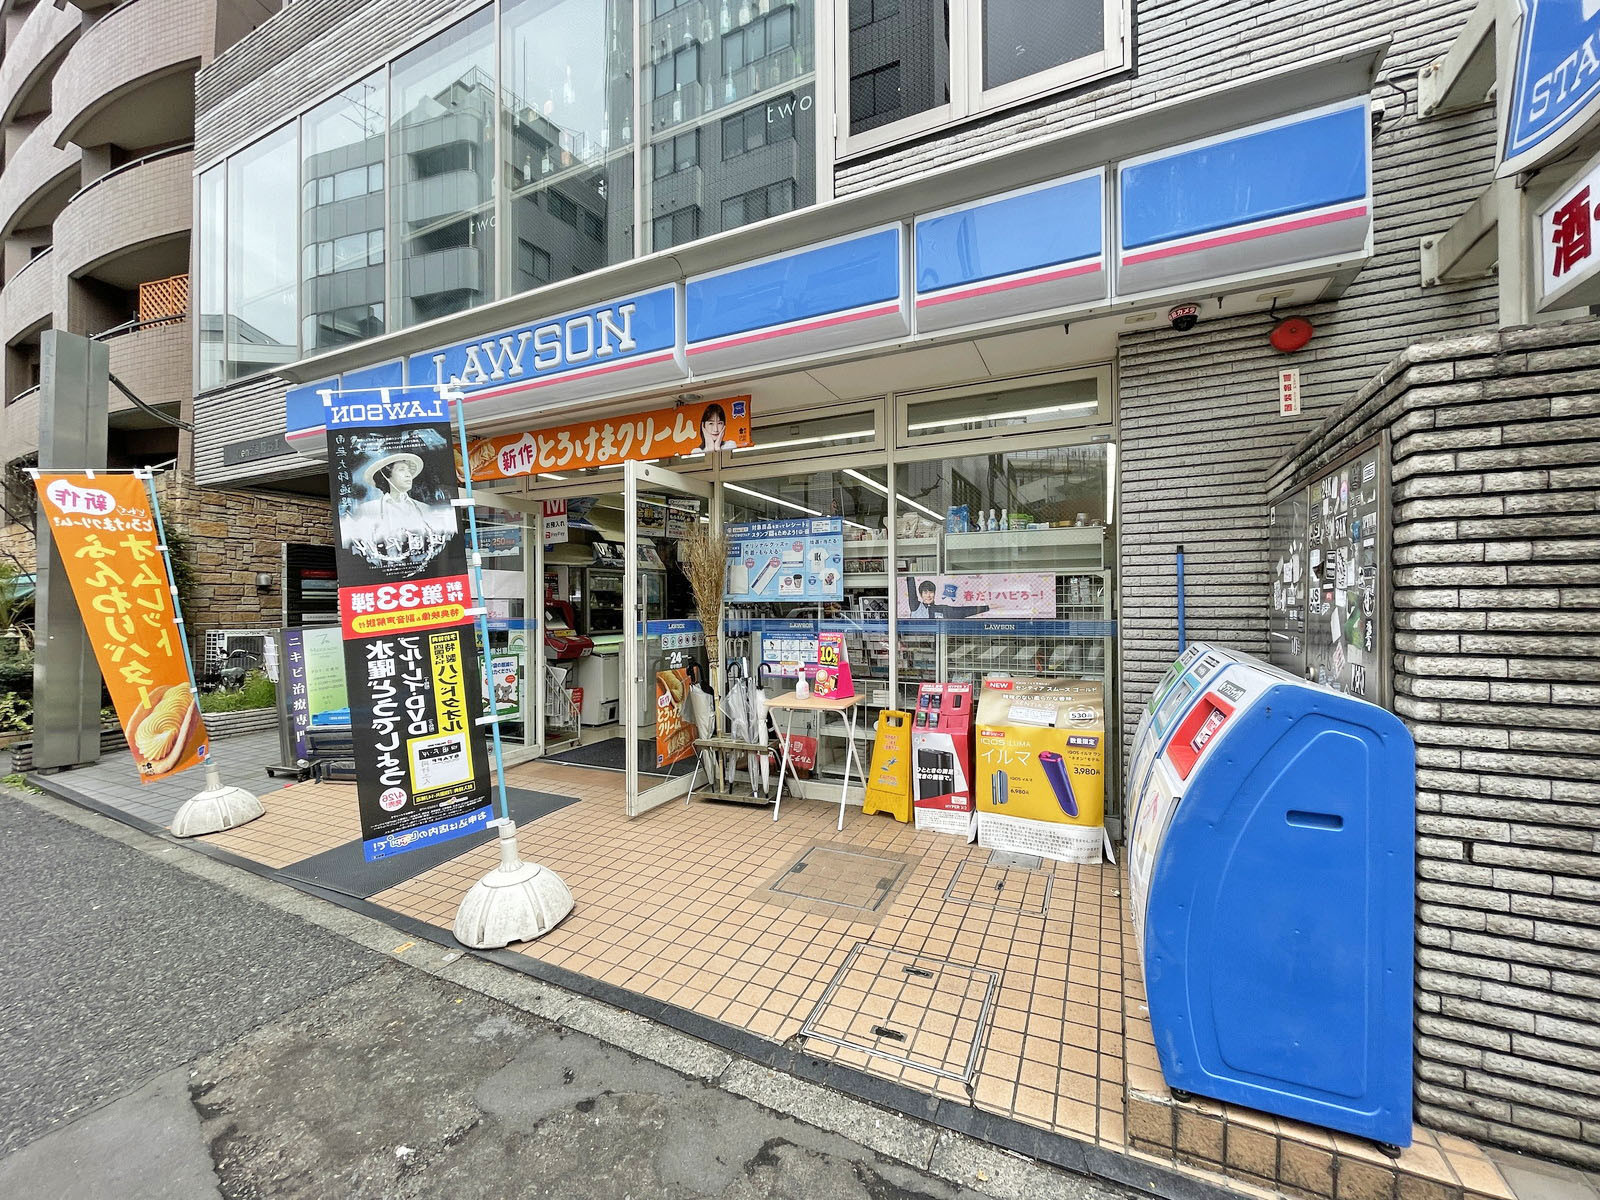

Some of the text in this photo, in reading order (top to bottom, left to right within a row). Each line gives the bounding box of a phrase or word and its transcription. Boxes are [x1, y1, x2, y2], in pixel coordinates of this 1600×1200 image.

[1529, 33, 1600, 121] STA
[766, 95, 812, 124] two
[1551, 185, 1600, 277] 酒
[433, 303, 637, 392] LAWSON
[502, 443, 535, 471] 新作
[538, 412, 697, 467] とろけまクリーム
[545, 521, 566, 529] お預入れ
[670, 652, 683, 664] 24
[820, 646, 839, 664] 10%
[658, 721, 682, 736] クリーム
[980, 738, 1006, 746] IQOS
[786, 754, 812, 764] マルチコ
[981, 749, 1031, 766] イルマ
